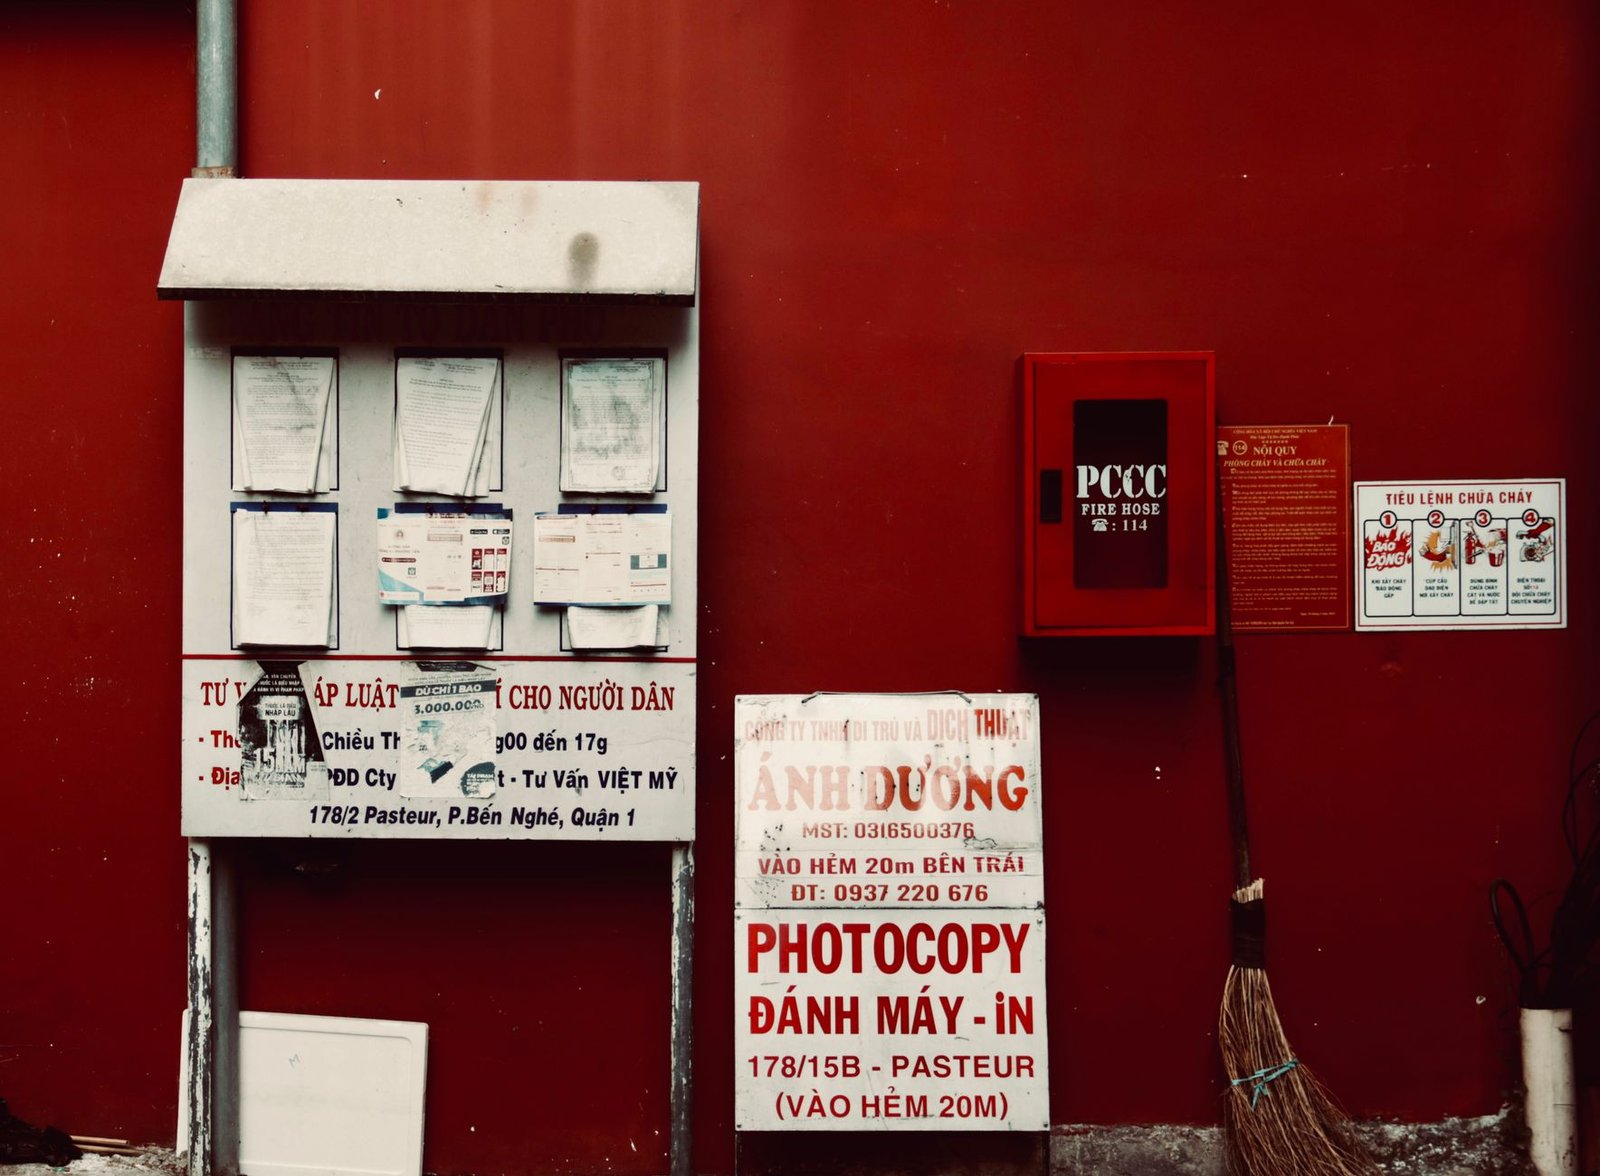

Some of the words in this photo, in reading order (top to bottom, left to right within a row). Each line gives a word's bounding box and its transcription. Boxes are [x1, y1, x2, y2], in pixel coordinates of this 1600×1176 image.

[1253, 444, 1272, 457] NỘI
[1274, 446, 1297, 456] QUY
[1224, 459, 1250, 467] PHÒNG
[1250, 458, 1272, 466] CHÁY
[1284, 458, 1304, 466] CHỮA
[1306, 458, 1327, 466] CHÁY
[1076, 464, 1167, 498] PCCC
[1386, 490, 1414, 505] TIÊU
[1420, 490, 1453, 507] LỆNH
[1458, 489, 1494, 504] CHỮA
[1499, 488, 1533, 504] CHÁY
[1081, 503, 1117, 516] FIRE
[1121, 503, 1160, 516] HOSE
[1384, 514, 1391, 525] 1
[1431, 513, 1441, 524] 2
[1479, 512, 1488, 524] 3
[1524, 512, 1536, 522] 4
[1122, 519, 1148, 532] 114
[200, 678, 228, 706] TƯ
[314, 675, 338, 707] ÁP
[345, 678, 399, 712] LUẬT
[509, 684, 551, 710] CHO
[558, 678, 623, 710] NGƯỜI
[631, 681, 674, 710] DÂN
[458, 684, 482, 694] BAO
[322, 728, 374, 750] Chiều
[533, 730, 567, 751] đến
[575, 732, 608, 754] 17g
[789, 721, 805, 741] TY
[212, 766, 240, 790] Địa
[366, 768, 396, 791] Cty
[522, 770, 548, 788] Tư
[553, 768, 588, 788] Vấn
[598, 766, 642, 794] VIỆT
[649, 766, 678, 790] MỸ
[748, 751, 850, 811] ÁNH
[864, 753, 1028, 812] DƯƠNG
[310, 806, 359, 826] 178/2
[364, 806, 440, 828] Pasteur,
[447, 803, 503, 826] P.Bến
[511, 806, 564, 830] Nghé,
[571, 807, 619, 832] Quận
[627, 808, 636, 826] 1
[802, 822, 848, 838] MST:
[854, 822, 975, 838] 0316500376
[758, 852, 801, 874] VÀO
[810, 852, 857, 874] HẺM
[865, 857, 914, 874] 20m
[923, 852, 966, 874] BÊN
[973, 851, 1025, 873] TRÁI
[791, 885, 825, 902] ĐT:
[834, 885, 889, 902] 0937
[897, 884, 940, 902] 220
[948, 884, 988, 902] 676
[748, 922, 1030, 974] PHOTOCOPY
[748, 985, 860, 1034] ĐÁNH
[877, 985, 964, 1034] MÁY
[748, 1055, 861, 1078] 178/15B
[892, 1054, 1035, 1078] PASTEUR
[775, 1089, 852, 1121] (VÀO
[861, 1086, 928, 1118] HẺM
[940, 1092, 1008, 1121] 20M)
